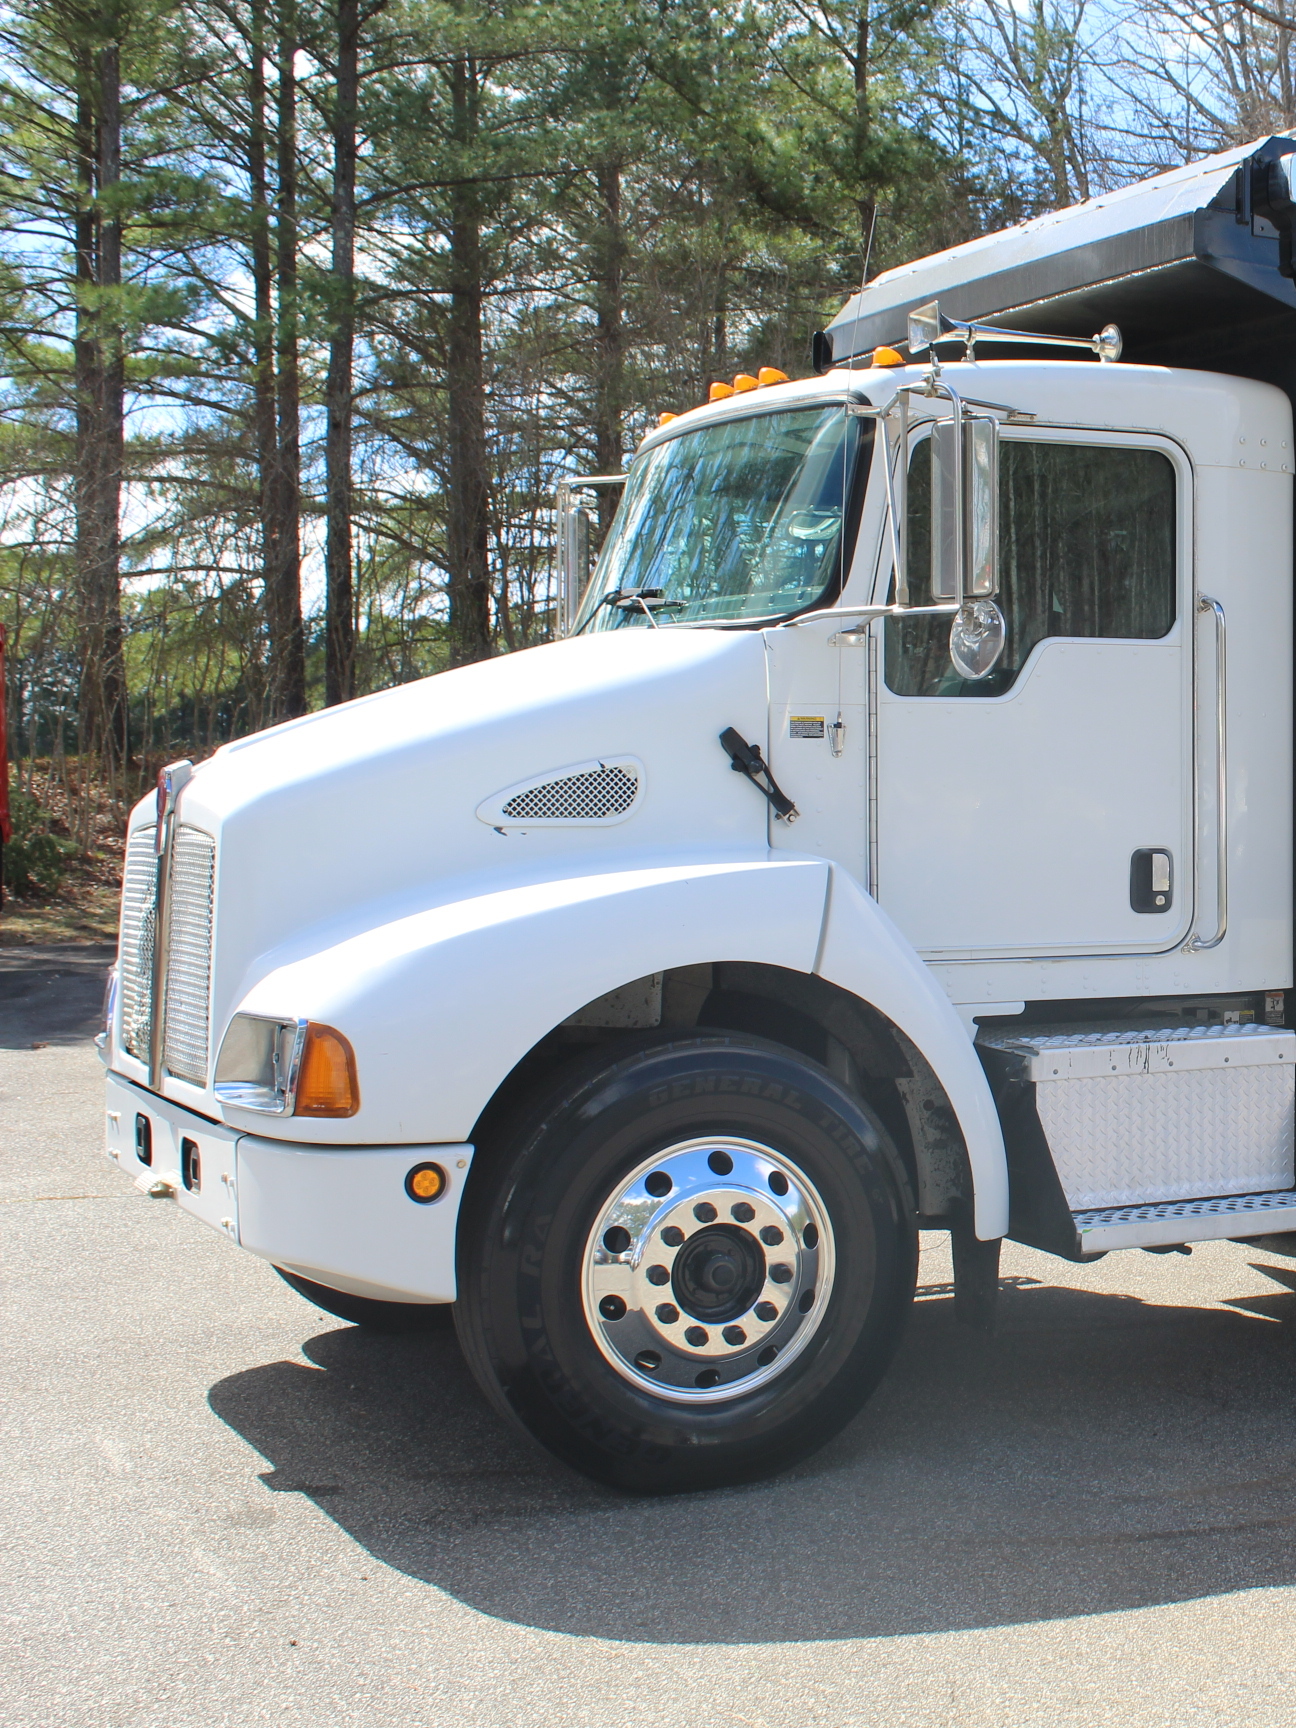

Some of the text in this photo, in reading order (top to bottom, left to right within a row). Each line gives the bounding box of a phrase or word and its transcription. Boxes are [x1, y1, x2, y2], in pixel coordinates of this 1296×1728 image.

[650, 1075, 873, 1175] GENERAL TIRE
[522, 1303, 673, 1464] GENERAL
